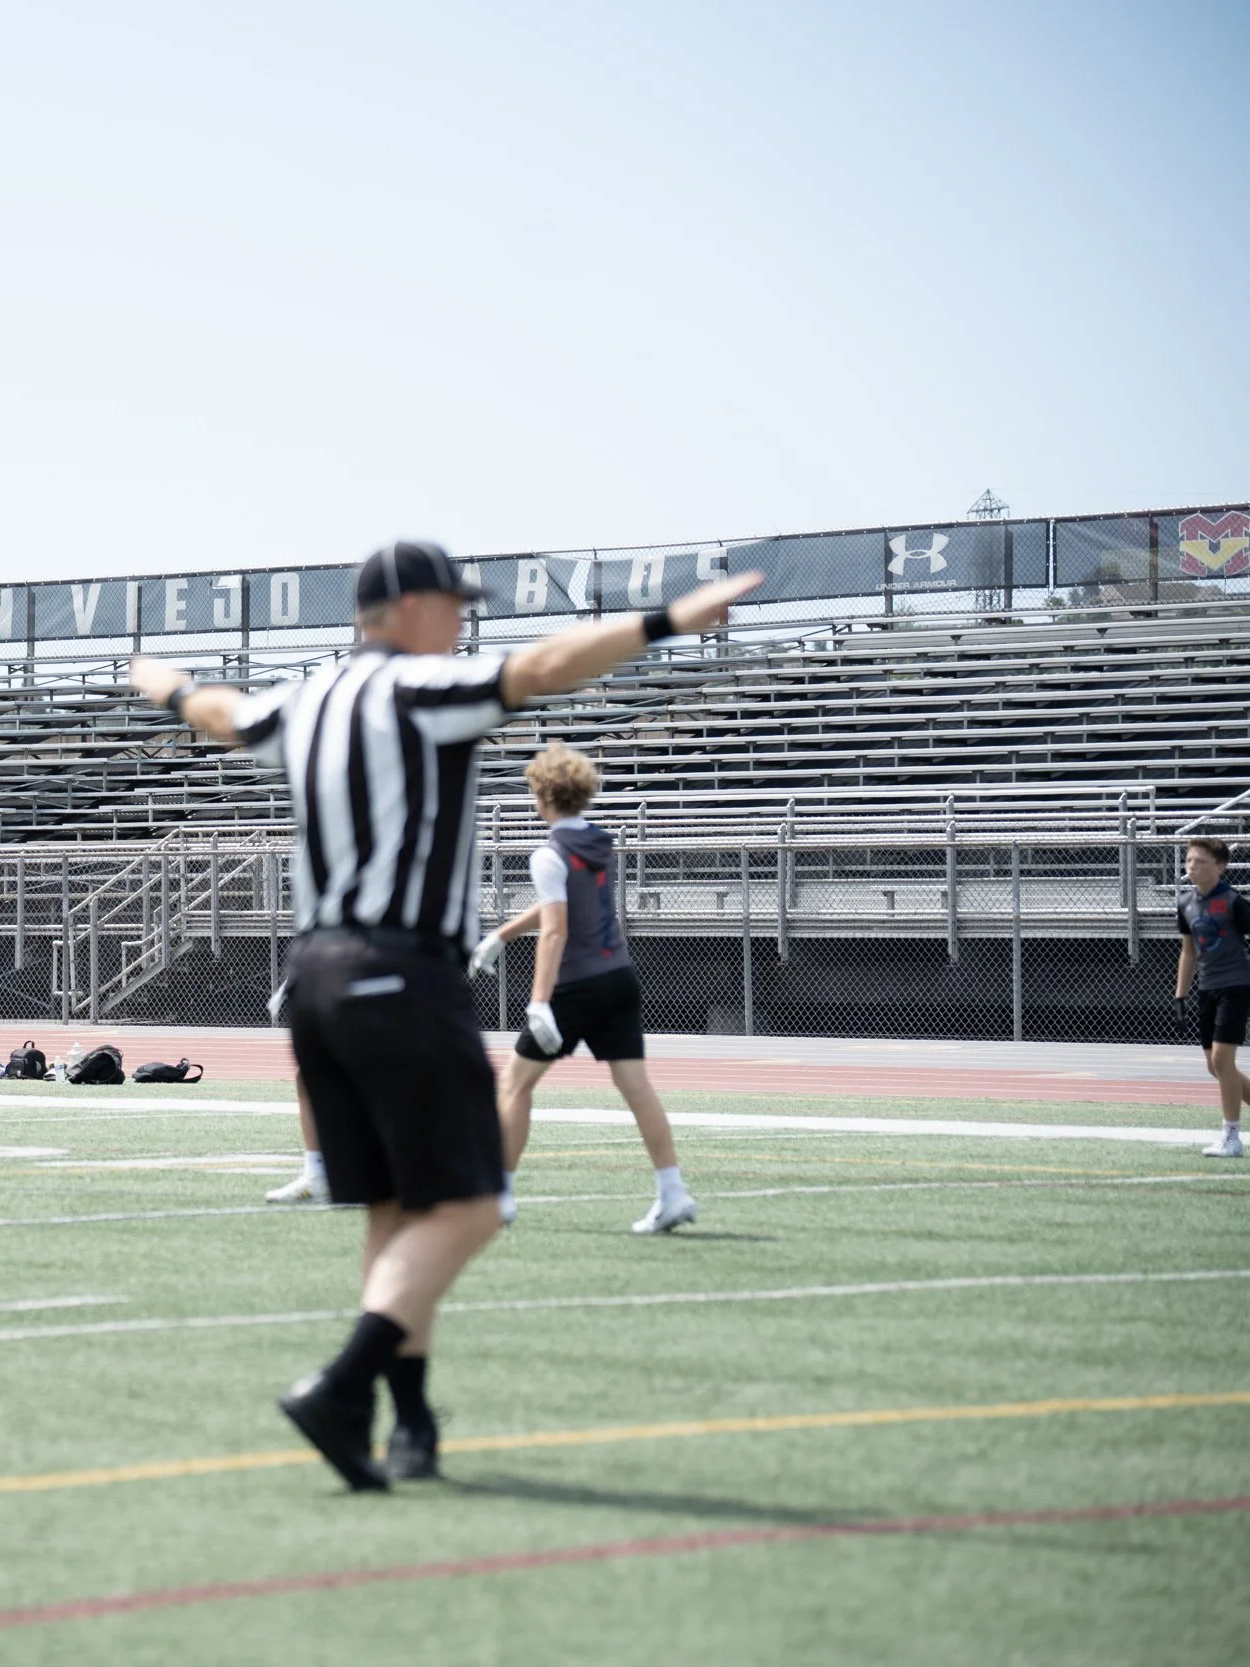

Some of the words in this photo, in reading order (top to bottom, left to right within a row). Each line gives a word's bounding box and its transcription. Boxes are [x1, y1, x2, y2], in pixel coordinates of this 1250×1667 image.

[72, 571, 301, 634] VIEJO
[875, 582, 910, 590] UNDER
[913, 579, 957, 588] ARMOUR
